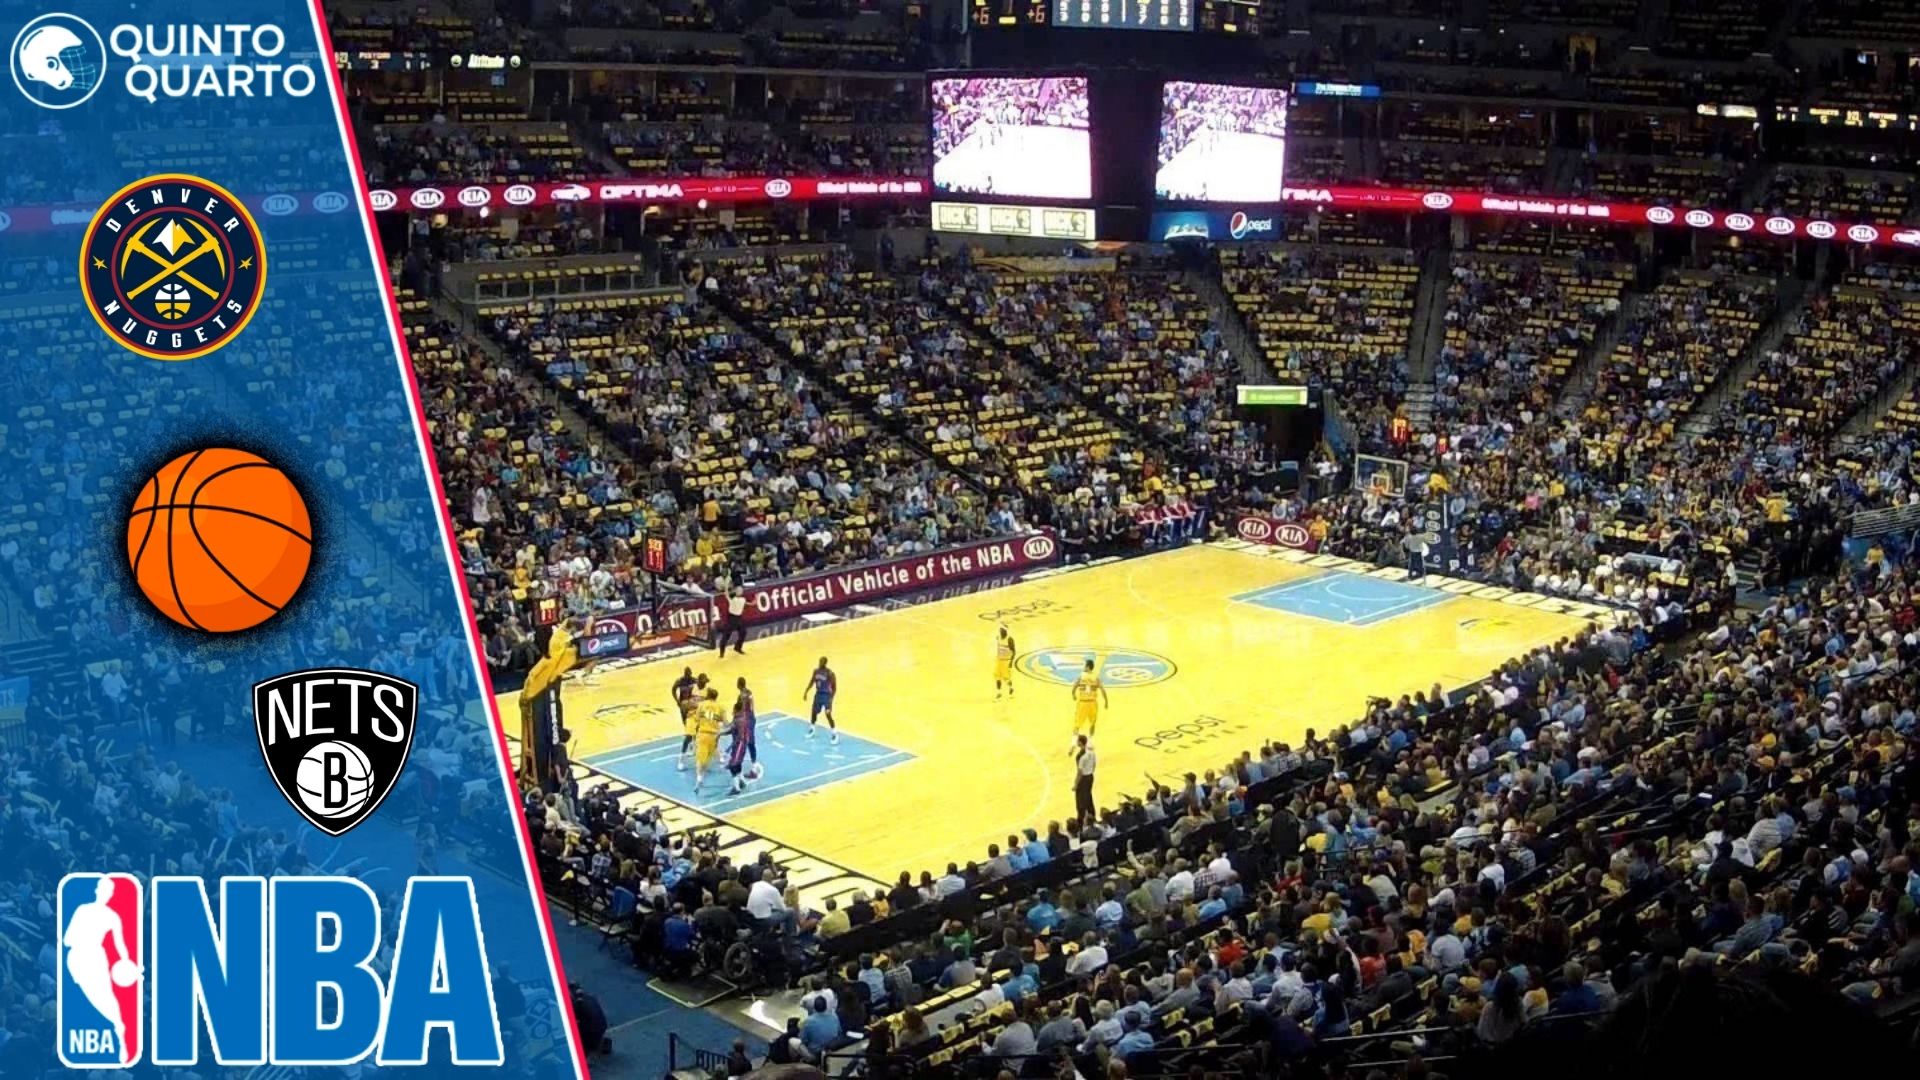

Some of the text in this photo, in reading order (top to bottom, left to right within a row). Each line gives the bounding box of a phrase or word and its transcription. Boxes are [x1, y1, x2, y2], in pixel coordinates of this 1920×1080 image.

[600, 184, 684, 199] OPTIMA
[1246, 219, 1272, 232] pepsi
[755, 583, 833, 613] Official
[838, 564, 910, 596] Vehicle
[916, 558, 935, 580] of
[941, 553, 972, 576] the
[976, 543, 1015, 569] NBA
[1134, 714, 1227, 750] pepsi
